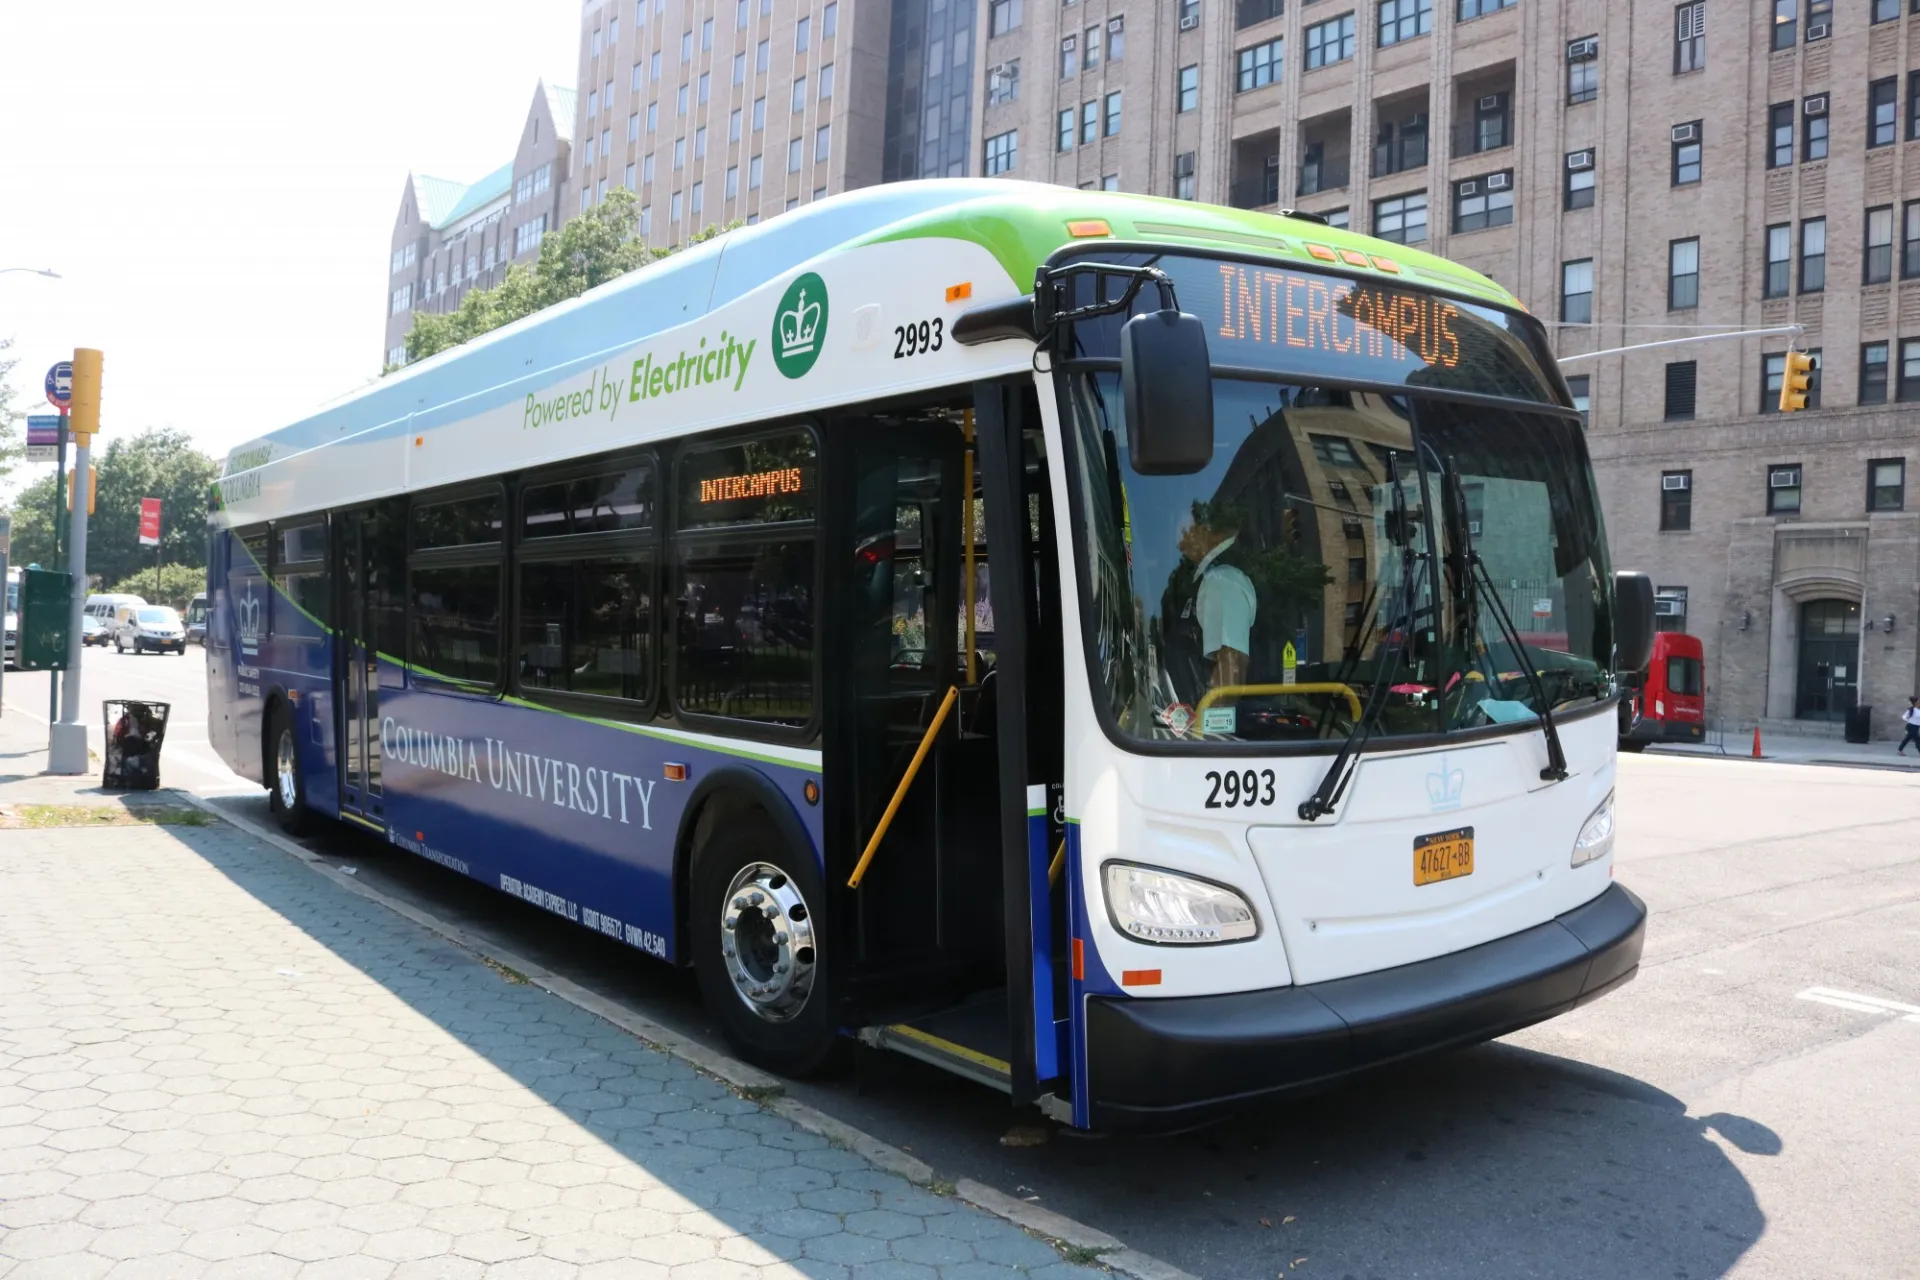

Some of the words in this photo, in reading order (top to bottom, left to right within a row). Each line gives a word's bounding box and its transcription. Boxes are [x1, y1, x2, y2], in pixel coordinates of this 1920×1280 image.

[894, 317, 943, 359] 2993
[1220, 264, 1459, 367] INTERCAMPUS
[523, 369, 597, 430] Powered
[600, 366, 624, 422] by
[628, 330, 757, 403] Electricity
[701, 468, 801, 502] INTERCAMPUS
[383, 716, 482, 784] COLUMBIA
[485, 737, 656, 831] UNIVERSITY
[1205, 768, 1276, 809] 2993
[421, 843, 470, 875] TRANSPORTATION
[523, 882, 545, 908] ACADEMY
[568, 901, 578, 922] LLC
[582, 906, 600, 932] USDOT
[625, 923, 643, 949] GVWR
